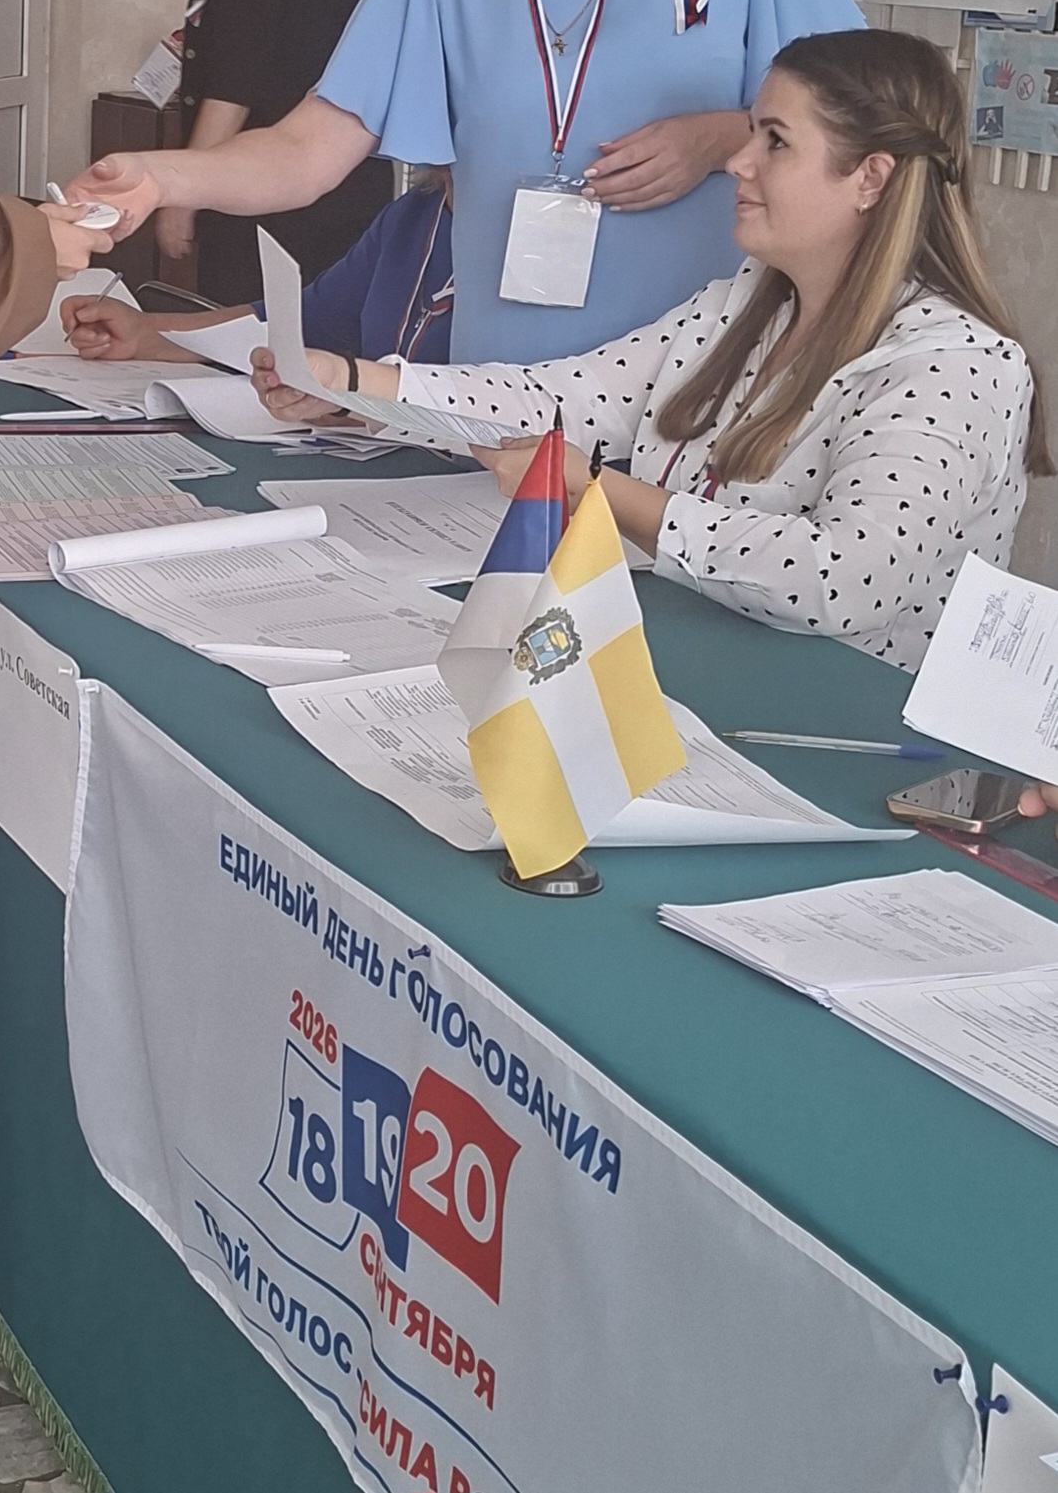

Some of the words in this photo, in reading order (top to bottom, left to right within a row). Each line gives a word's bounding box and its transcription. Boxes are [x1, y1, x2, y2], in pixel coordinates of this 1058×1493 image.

[0, 647, 14, 673] ул.
[16, 656, 70, 720] Советская
[220, 833, 318, 935] ЕДИНЫЙ
[323, 907, 385, 987] ДЕНЬ
[389, 957, 622, 1195] ГОЛОСОВАНИЯ
[289, 989, 338, 1064] 2026
[287, 1096, 337, 1204] 18
[409, 1110, 497, 1243] 20
[256, 1267, 353, 1374] ГОЛОС
[360, 1379, 438, 1493] СИЛА
